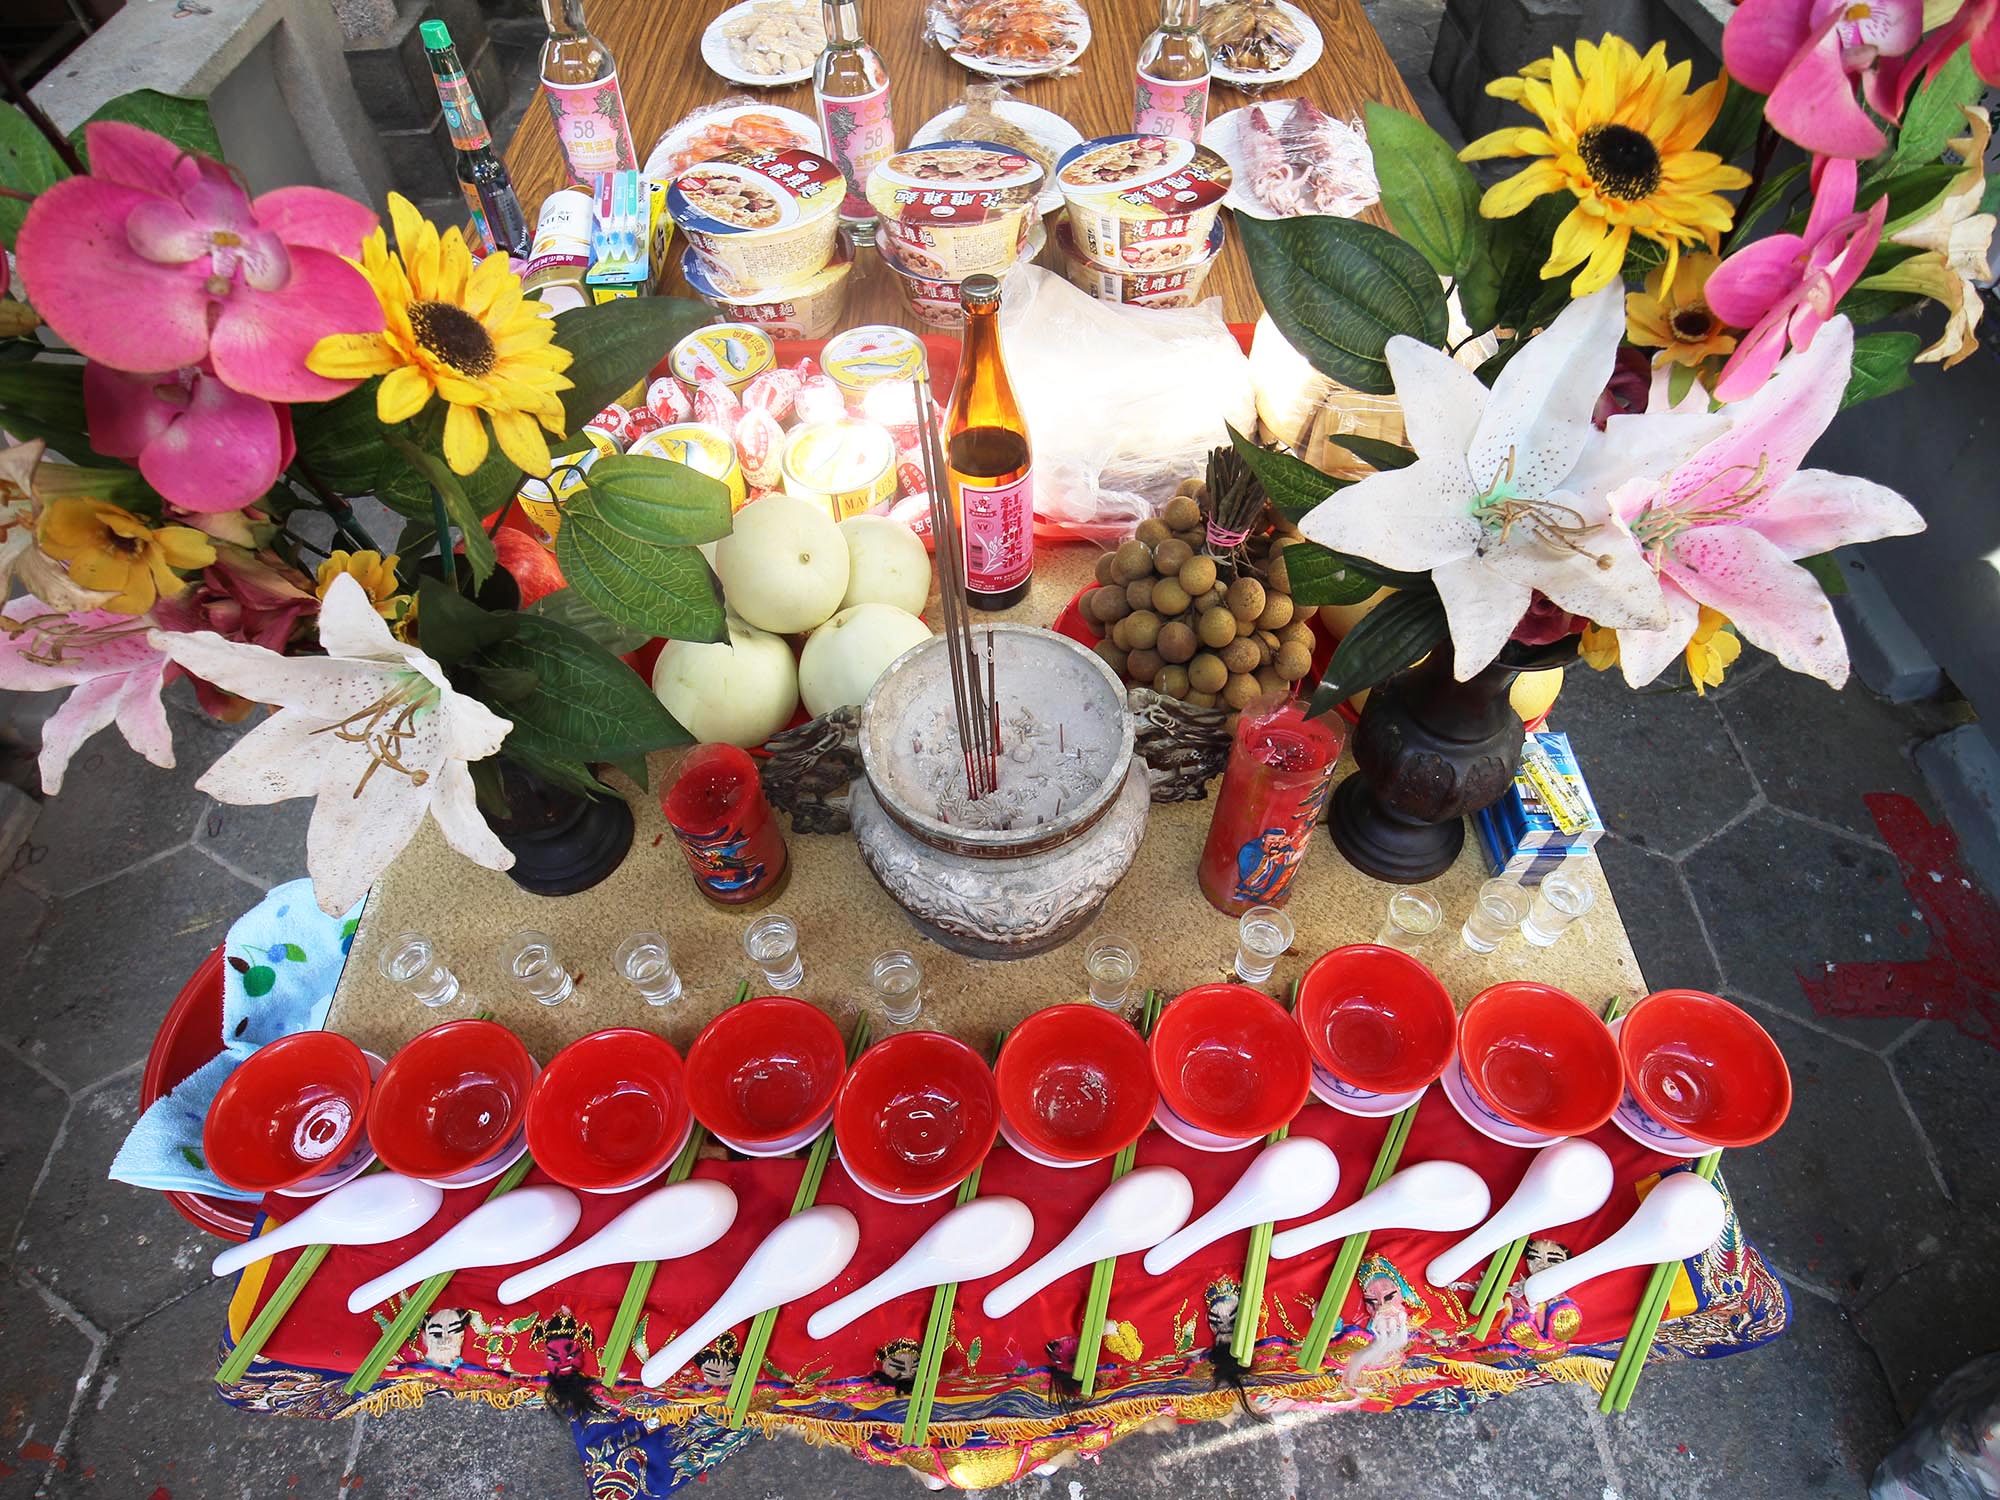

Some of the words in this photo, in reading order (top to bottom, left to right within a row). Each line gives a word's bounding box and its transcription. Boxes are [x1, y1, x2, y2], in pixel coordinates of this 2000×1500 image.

[573, 119, 595, 139] 58
[1151, 116, 1176, 135] 58
[864, 126, 884, 151] 58
